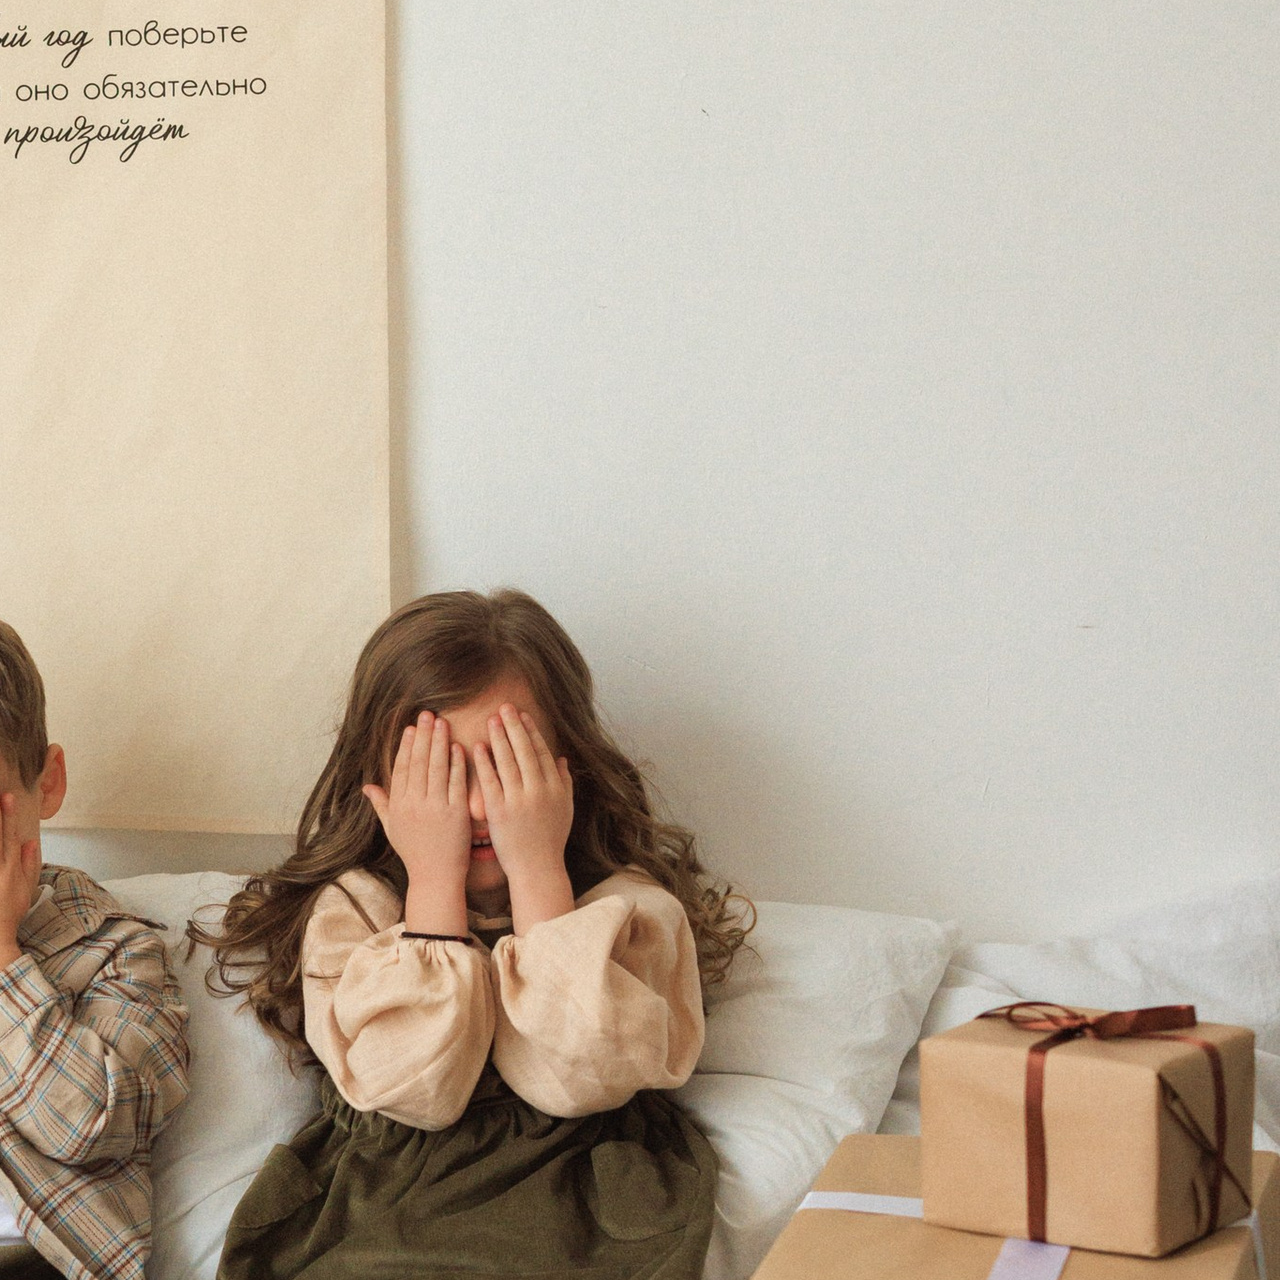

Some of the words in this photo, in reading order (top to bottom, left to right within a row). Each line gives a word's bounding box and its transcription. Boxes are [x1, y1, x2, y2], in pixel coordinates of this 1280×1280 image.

[42, 29, 94, 69] год
[108, 19, 248, 48] поверьте
[15, 83, 69, 102] оно
[83, 73, 267, 100] обязательно
[3, 115, 190, 165] произойдёт
